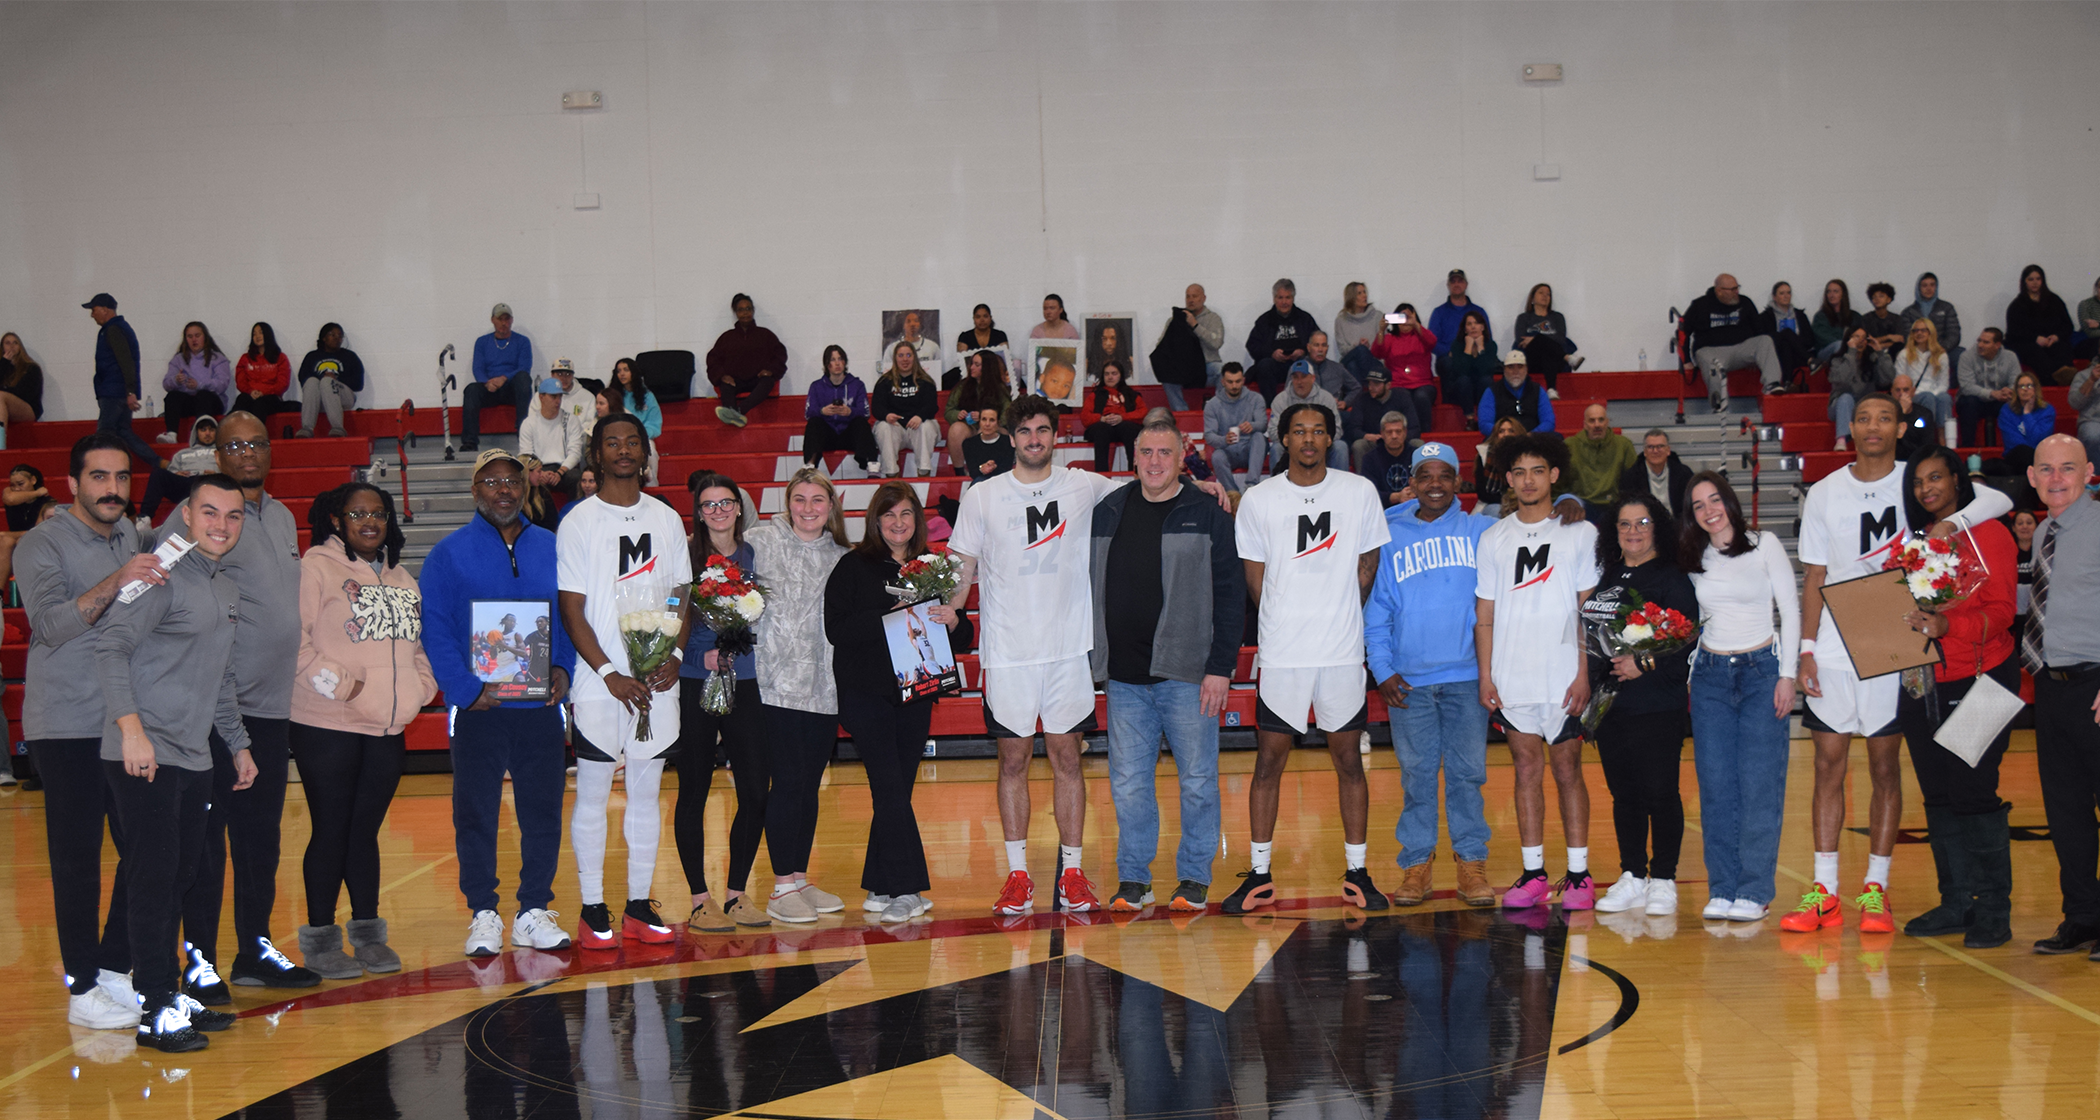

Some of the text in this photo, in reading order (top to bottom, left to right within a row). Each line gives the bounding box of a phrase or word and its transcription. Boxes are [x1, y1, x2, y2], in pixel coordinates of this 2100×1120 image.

[1025, 500, 1060, 545] M
[1296, 510, 1331, 554] M
[1860, 505, 1897, 555] M
[618, 533, 652, 577] M
[1393, 535, 1477, 583] CAROLINA
[1513, 543, 1551, 586] M
[902, 687, 912, 702] M
